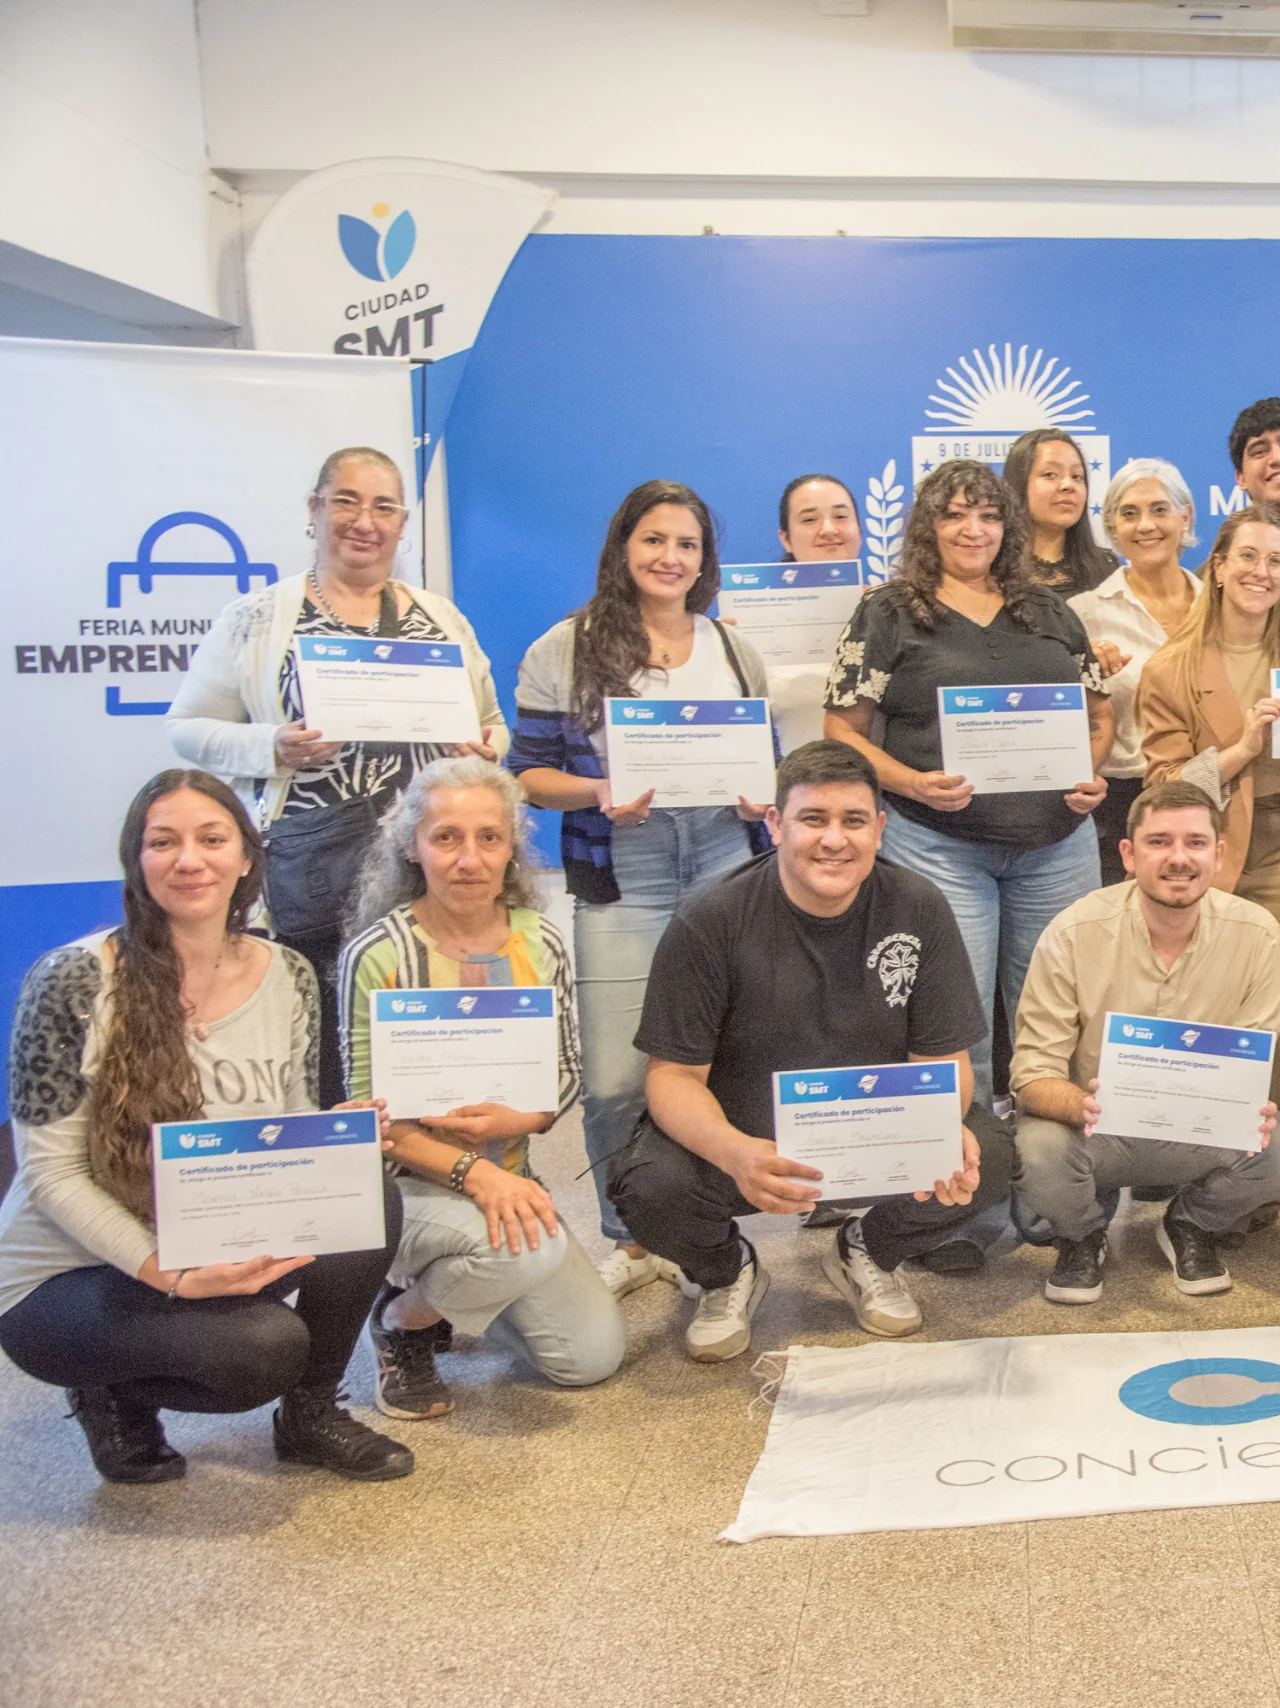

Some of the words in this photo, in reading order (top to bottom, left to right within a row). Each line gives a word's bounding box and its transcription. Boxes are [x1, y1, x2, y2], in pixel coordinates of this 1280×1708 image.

[345, 283, 429, 320] CIUDAD
[334, 303, 444, 357] SMT
[938, 443, 945, 457] 9
[954, 443, 970, 457] DE
[79, 619, 145, 636] FERIA
[151, 619, 212, 636] MUNI
[15, 644, 199, 674] EMPREN
[808, 1086, 829, 1094] SMT
[794, 1108, 838, 1120] Certificado
[851, 1104, 905, 1117] participación
